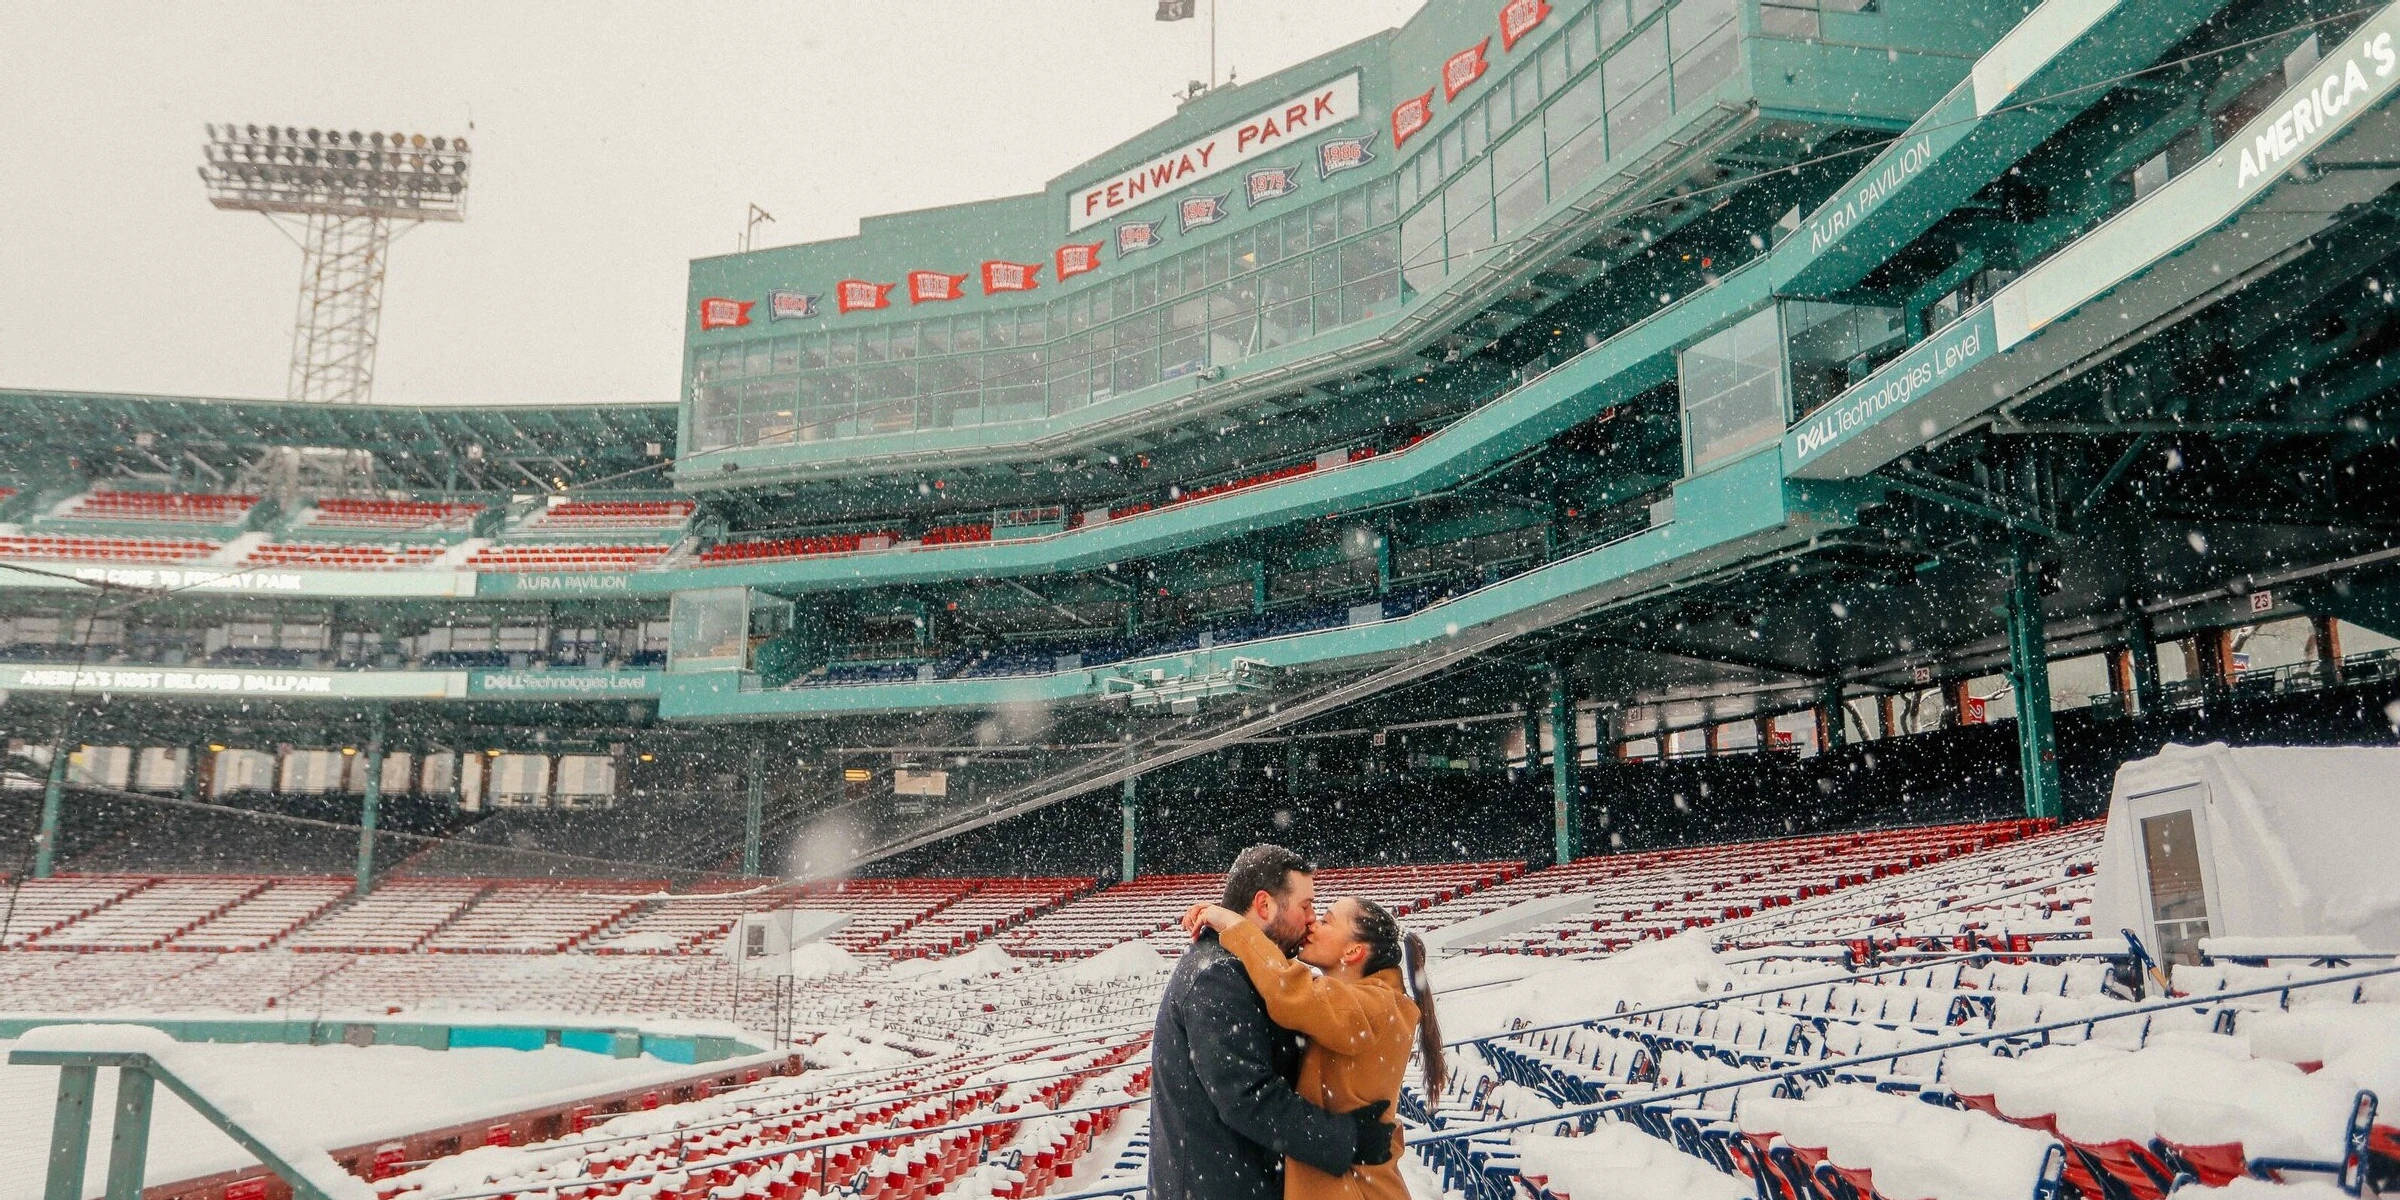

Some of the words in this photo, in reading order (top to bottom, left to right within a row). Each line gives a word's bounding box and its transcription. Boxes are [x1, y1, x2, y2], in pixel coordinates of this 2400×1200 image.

[2238, 32, 2395, 189] AMERICA'S
[1086, 141, 1216, 217] FENWAY
[1238, 91, 1334, 153] PARK
[1324, 144, 1361, 163] 1986
[1859, 135, 1931, 213] PAVILION
[1251, 174, 1286, 194] 1975
[1183, 202, 1216, 219] 1967
[1120, 227, 1150, 245] 1946
[1796, 420, 1838, 459] DELL
[1834, 363, 1932, 434] Technologies
[1934, 324, 1980, 374] Level
[158, 570, 180, 585] TO
[256, 574, 300, 589] PARK
[565, 576, 627, 590] PAVILION
[2254, 594, 2268, 609] 23
[164, 673, 240, 690] BELOVED
[243, 674, 331, 692] BALLPARK
[527, 675, 608, 691] Technologies
[611, 675, 645, 688] Level
